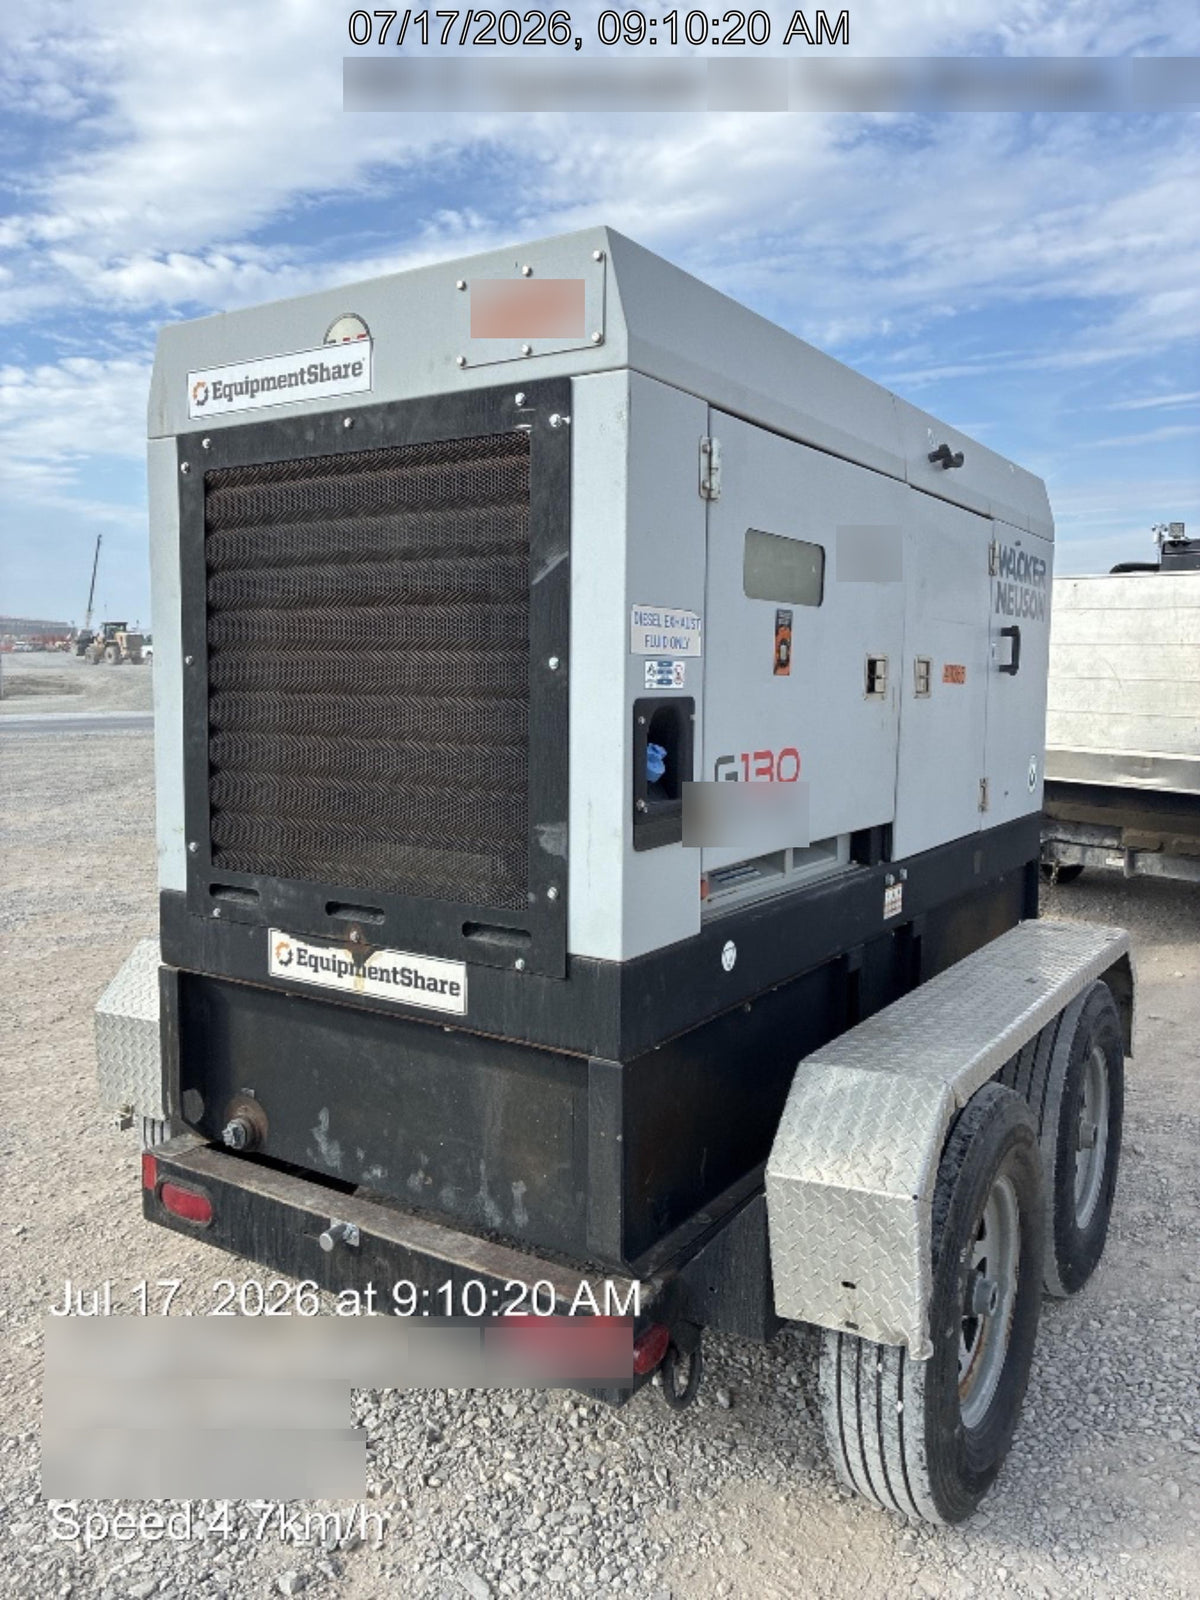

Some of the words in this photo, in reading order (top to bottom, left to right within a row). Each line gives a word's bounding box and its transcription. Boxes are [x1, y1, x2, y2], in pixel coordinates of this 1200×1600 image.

[211, 359, 363, 403] EquipmentShare
[633, 611, 661, 628] DIESEL
[995, 581, 1046, 623] NEUSON
[714, 748, 801, 782] G130
